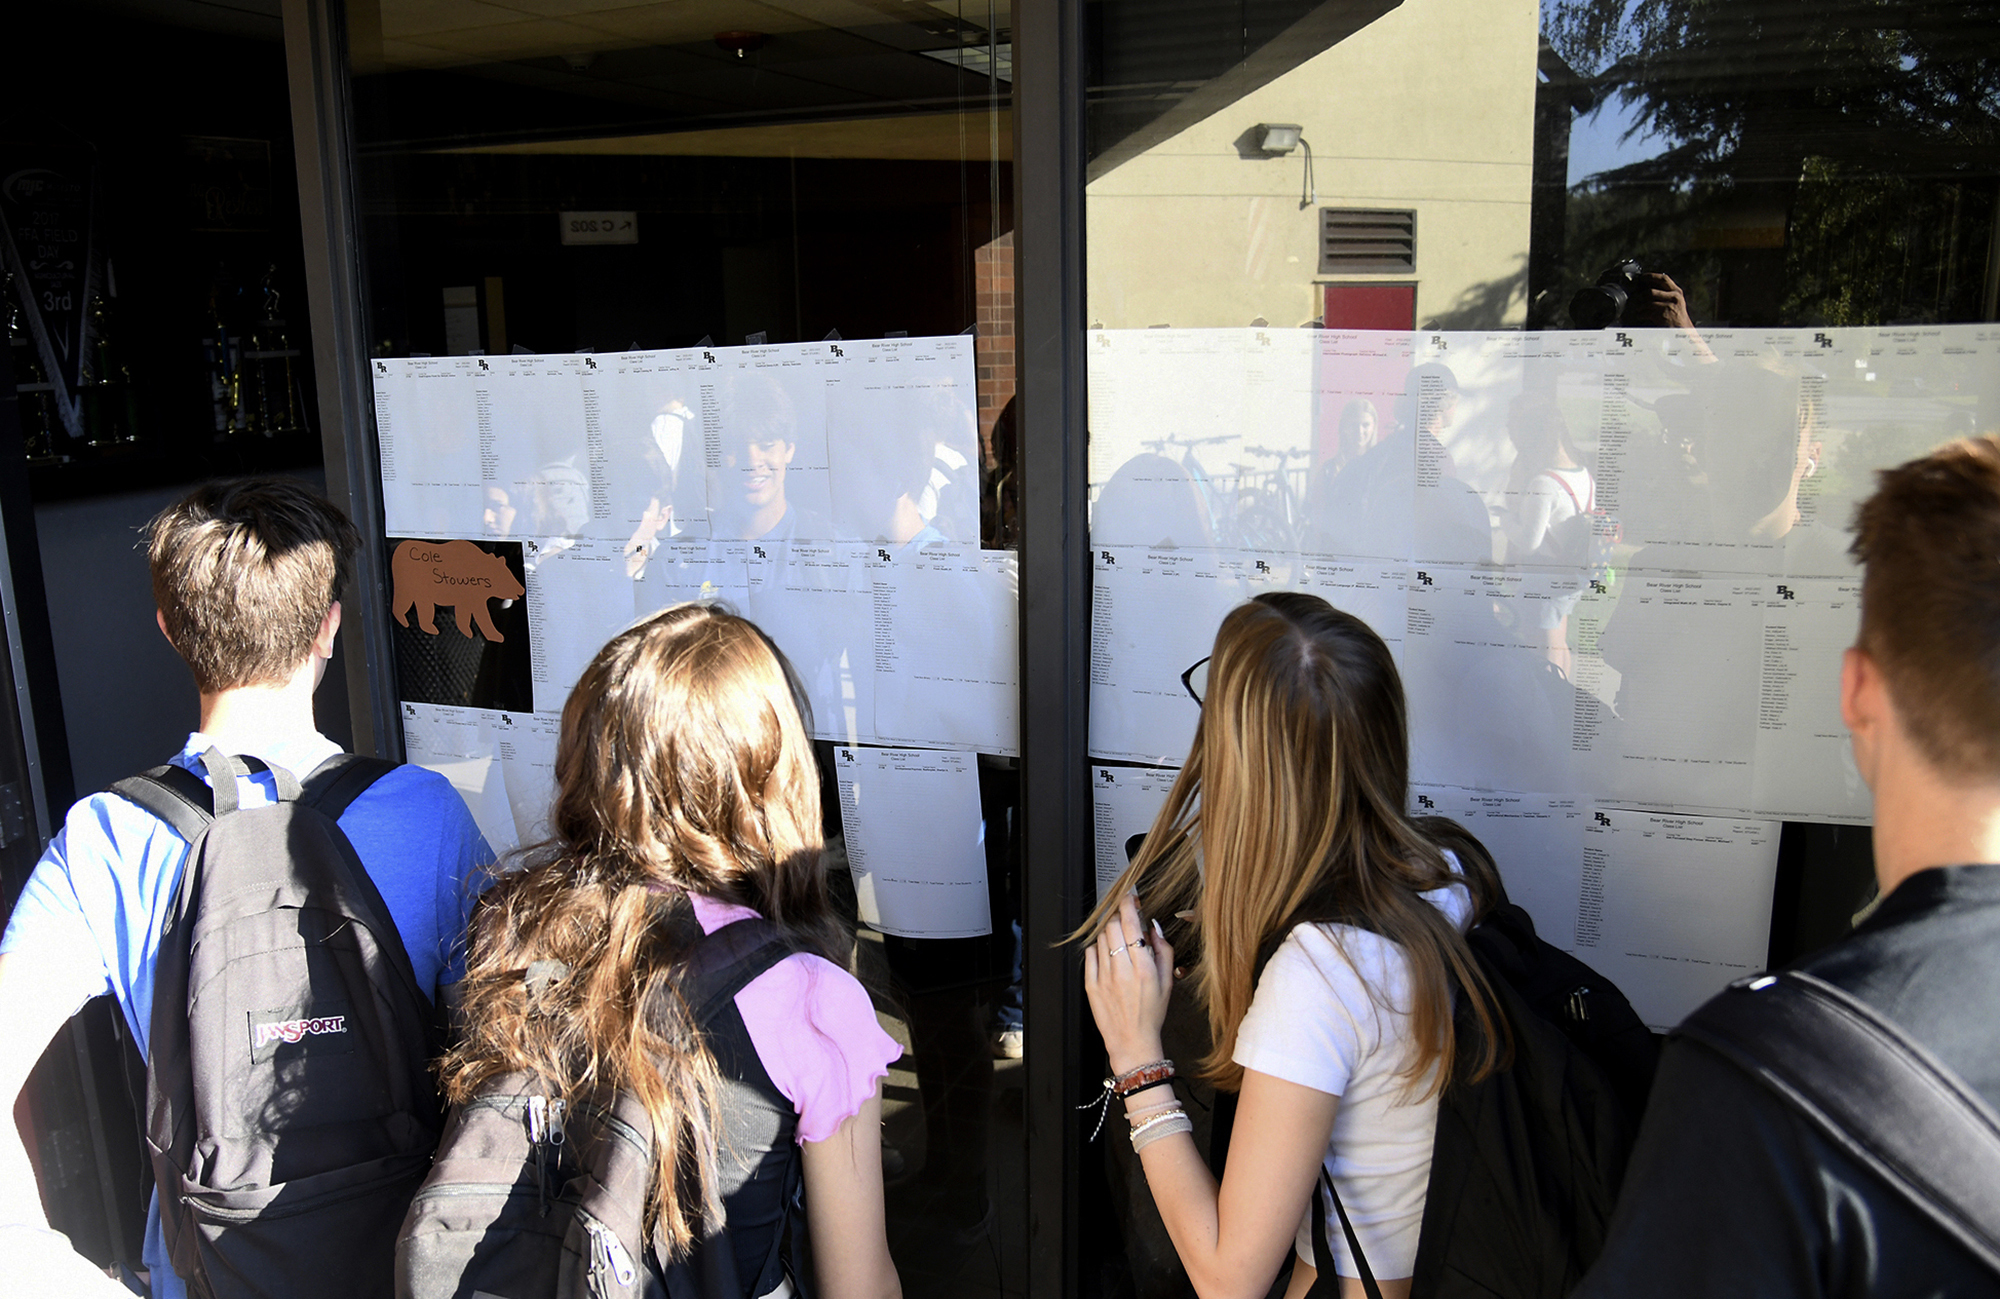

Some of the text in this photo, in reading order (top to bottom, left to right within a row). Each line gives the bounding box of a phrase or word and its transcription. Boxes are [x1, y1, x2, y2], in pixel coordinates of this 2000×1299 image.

[32, 211, 60, 226] 2017
[18, 227, 78, 243] FFA FIELD
[37, 245, 59, 259] DAY
[43, 290, 72, 312] 3rd
[1431, 336, 1447, 350] BR
[1616, 333, 1633, 348] BR
[1814, 333, 1832, 348] BR
[703, 351, 716, 364] BR
[830, 345, 844, 357] BR
[377, 362, 387, 373] BR
[478, 359, 489, 371] BR
[585, 357, 597, 369] BR
[528, 540, 539, 552] BR
[753, 546, 766, 559] BR
[409, 546, 443, 563] Cole
[878, 549, 891, 562] BR
[1101, 551, 1115, 565] BR
[1256, 560, 1270, 574] BR
[432, 567, 492, 588] Stowers
[1417, 571, 1433, 586] BR
[1589, 580, 1607, 594] BR
[1776, 585, 1795, 600] BR
[406, 704, 416, 715] BR
[502, 714, 512, 725] BR
[842, 750, 855, 762] BR
[1100, 770, 1114, 782] BR
[1418, 795, 1434, 808] BR
[1594, 812, 1611, 826] BR
[255, 1015, 345, 1049] JANSPORT
